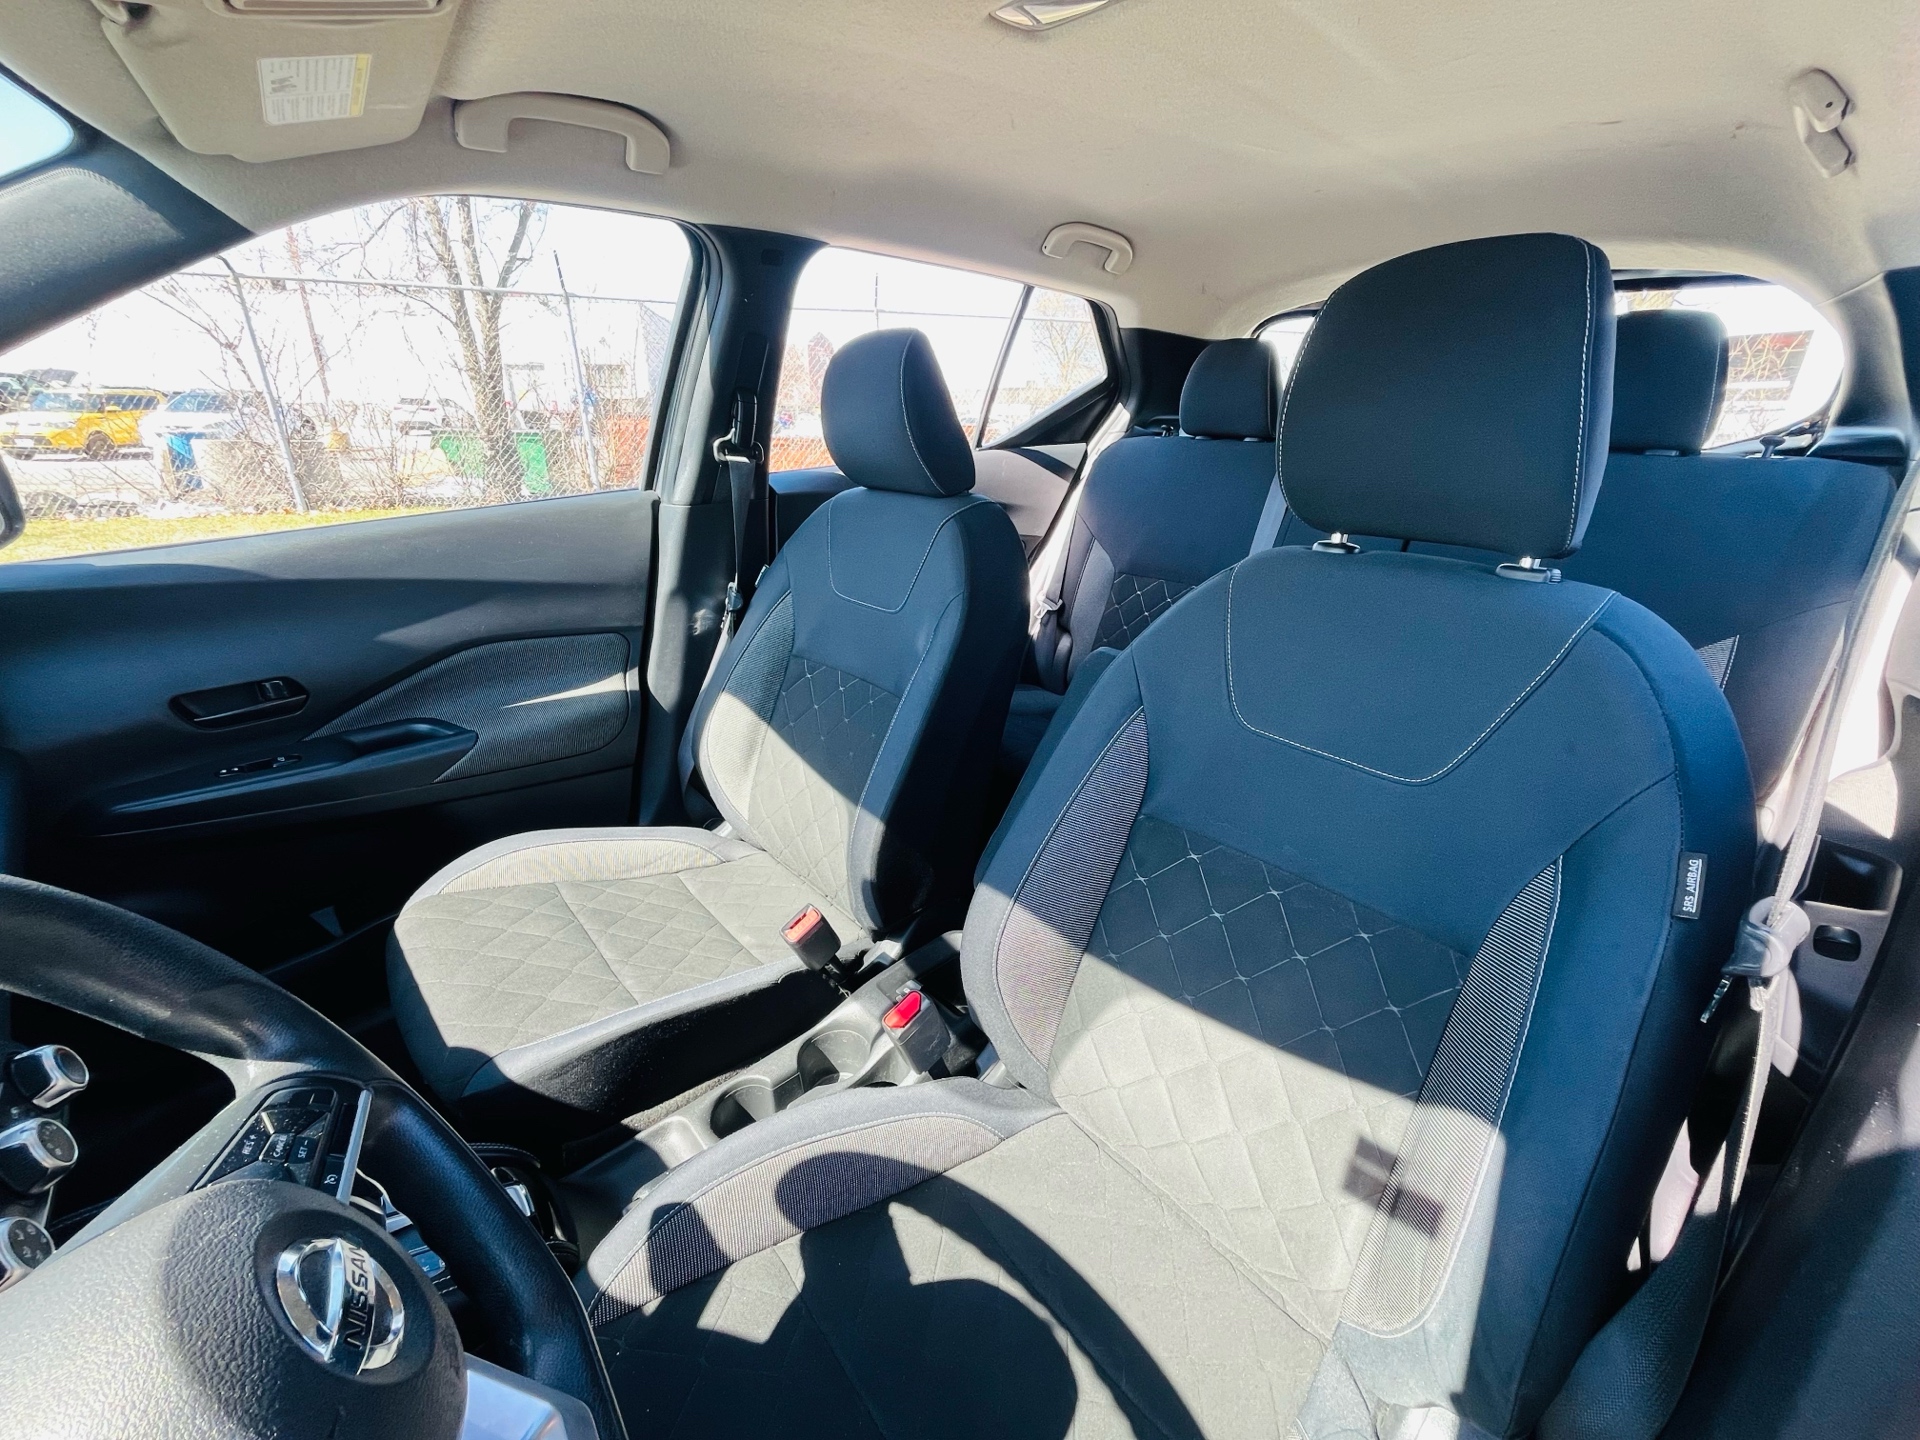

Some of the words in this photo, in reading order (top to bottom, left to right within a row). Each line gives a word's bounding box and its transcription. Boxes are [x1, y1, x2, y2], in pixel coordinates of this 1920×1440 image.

[1685, 859, 1699, 893] AIRBAG
[1682, 895, 1695, 912] SRS
[242, 1140, 255, 1155] RES
[298, 1147, 308, 1158] SET
[343, 1247, 369, 1351] NISSAN
